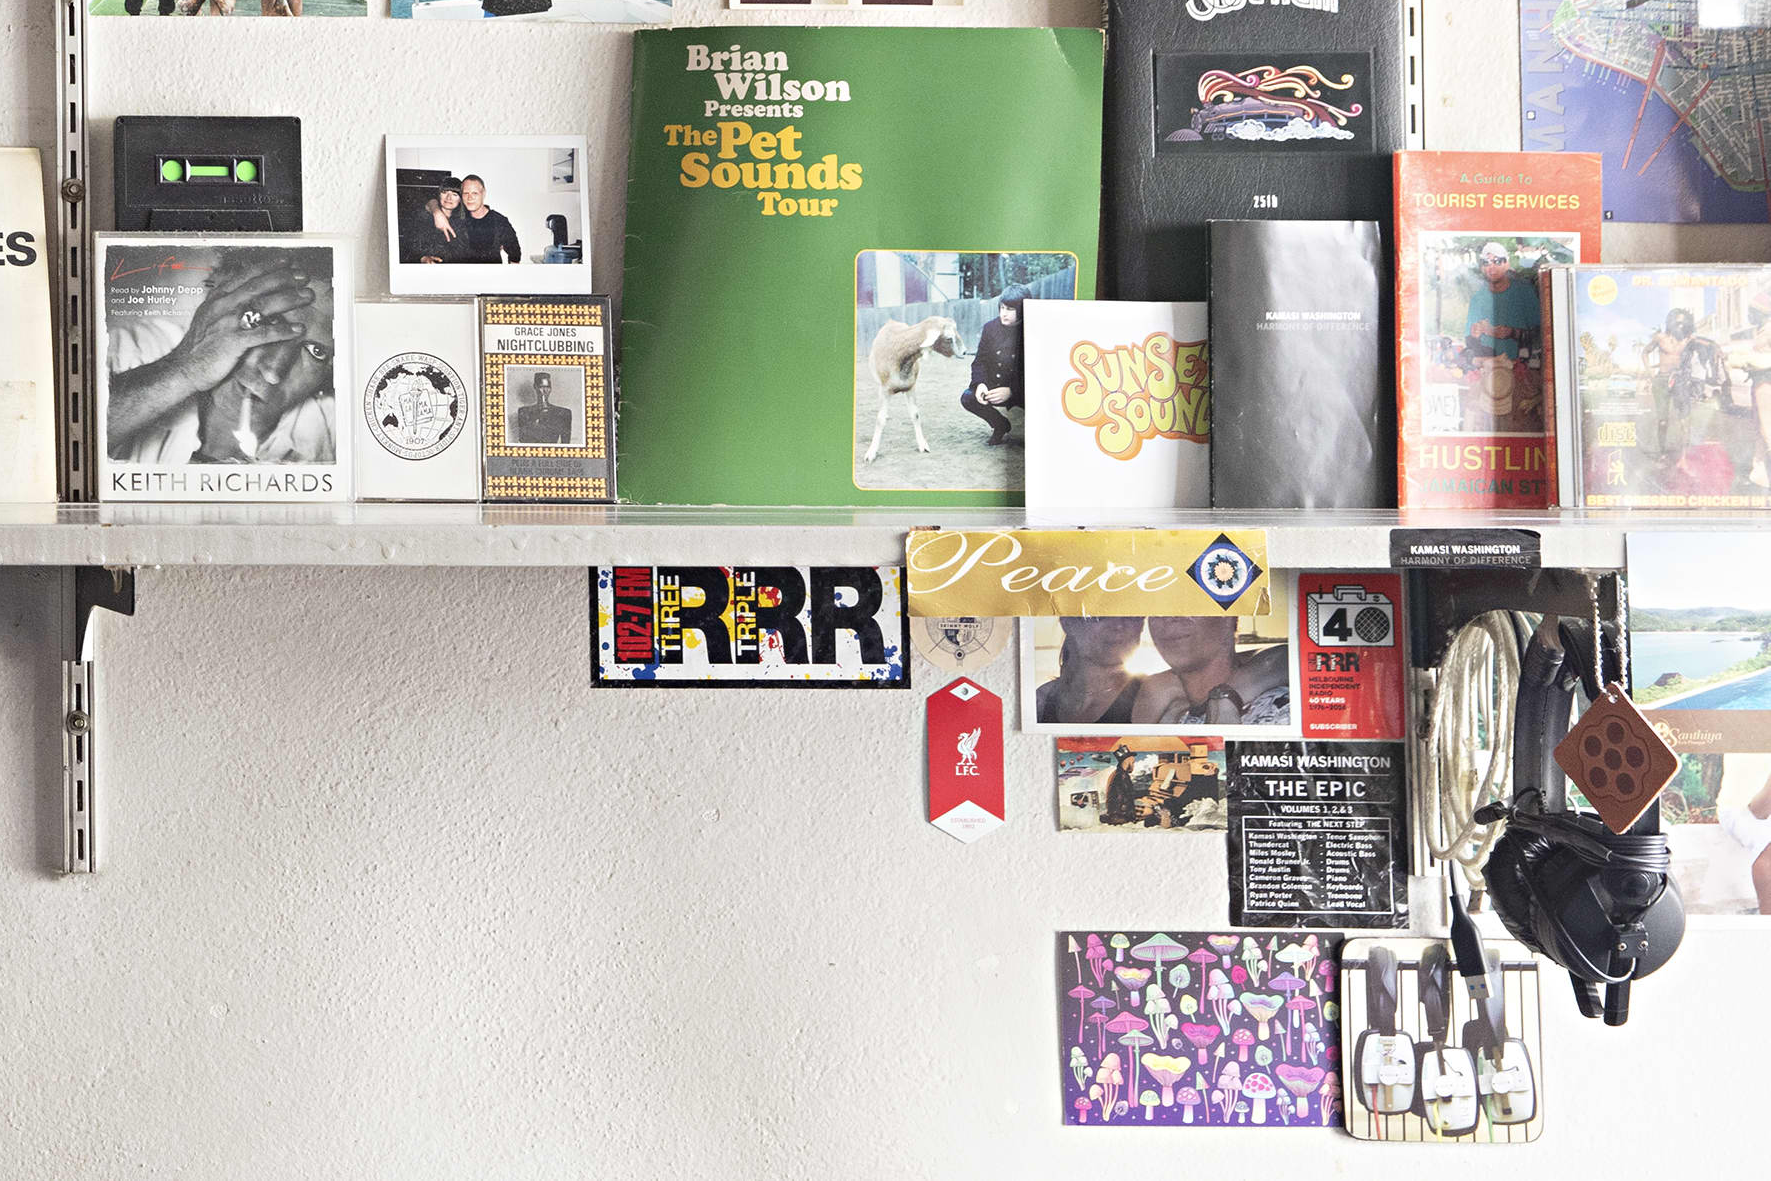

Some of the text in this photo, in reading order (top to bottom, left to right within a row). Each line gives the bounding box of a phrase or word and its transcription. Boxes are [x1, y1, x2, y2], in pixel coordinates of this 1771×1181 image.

[686, 44, 789, 72] Brian
[713, 71, 852, 102] Wilson
[703, 101, 804, 118] Presents
[663, 121, 802, 160] The Pet
[679, 153, 864, 190] Sounds
[1459, 173, 1470, 184] A
[1474, 173, 1512, 185] Guide
[757, 191, 838, 217] Tour
[1413, 194, 1581, 210] TOURIST SERVICES
[110, 285, 204, 296] Read by Johnny Depp
[111, 295, 177, 306] and Joe Hurley
[514, 326, 577, 338] GRACE JONES
[496, 338, 594, 354] NIGHTCLUBBING
[112, 473, 333, 492] KEITH RICHARDS
[1410, 544, 1521, 554] KAMASI WASHINGTON
[908, 530, 1180, 594] Peace
[1400, 556, 1532, 565] HARMONY OF DIFFERENCE
[660, 574, 681, 653] THREE
[737, 570, 758, 657] TRIPLE
[1666, 727, 1723, 746] Santhiya
[1241, 755, 1392, 768] KAMASI WASHINGTON
[1265, 780, 1366, 798] THE EPIC
